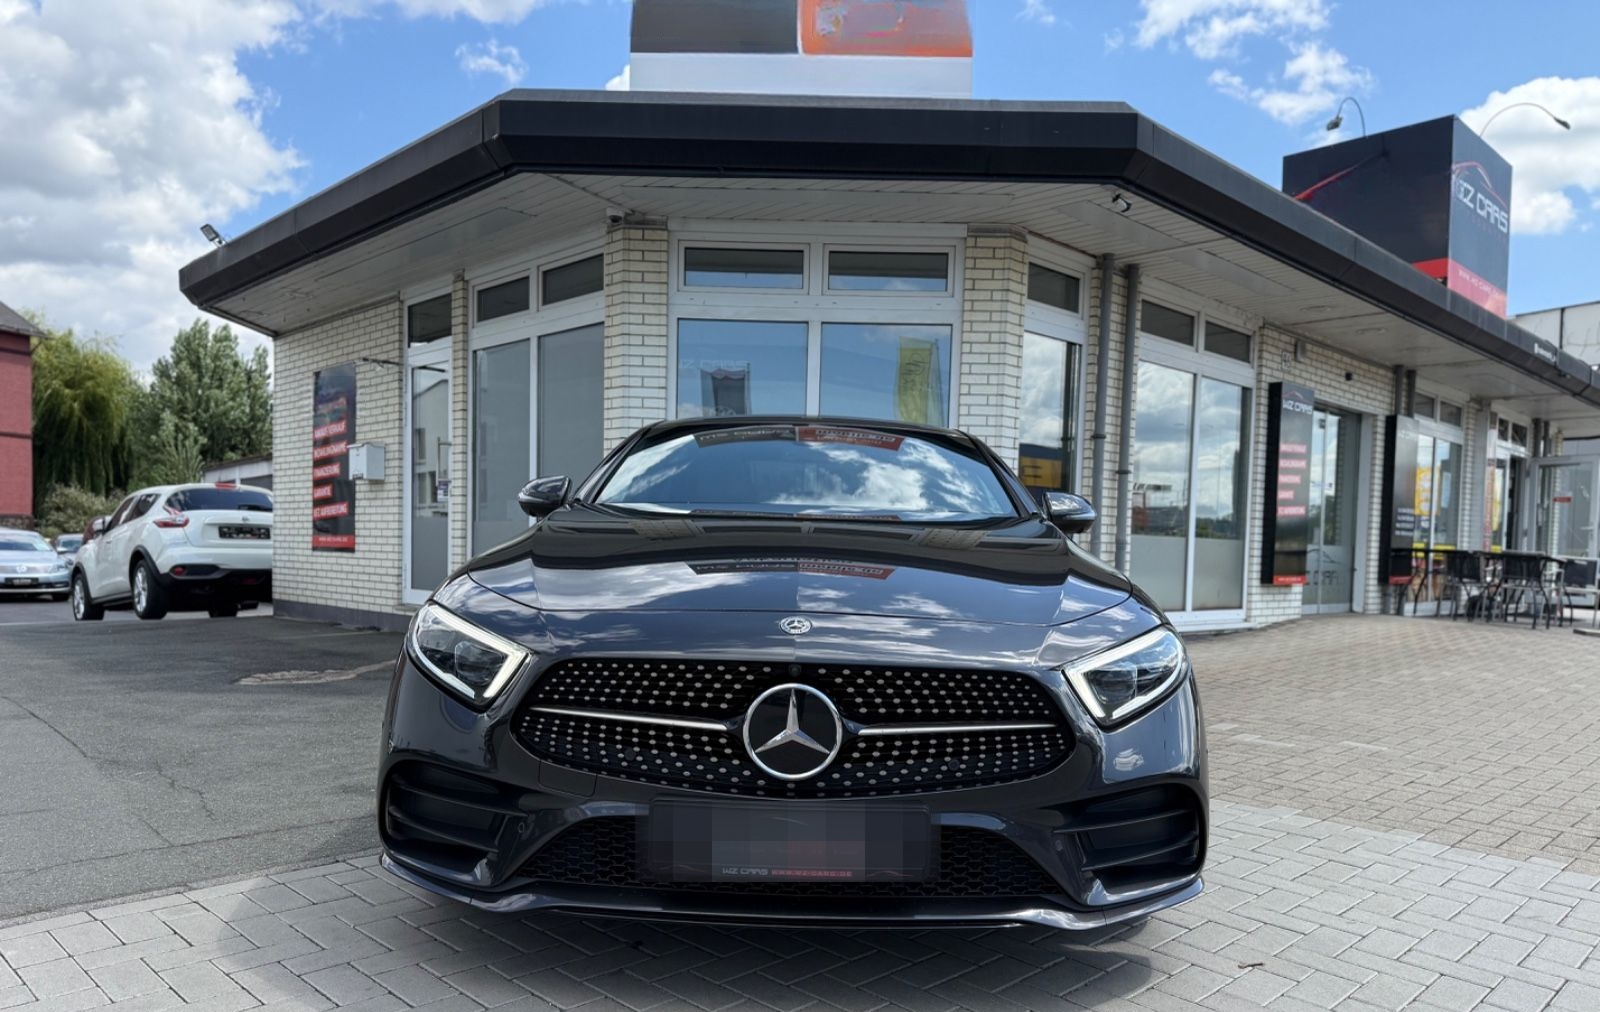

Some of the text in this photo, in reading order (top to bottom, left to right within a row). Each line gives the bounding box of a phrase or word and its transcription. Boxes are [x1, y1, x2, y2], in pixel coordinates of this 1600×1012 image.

[1476, 191, 1509, 234] CARS
[722, 867, 852, 877] WZ CARS WWW.WZ-CARS.DE
